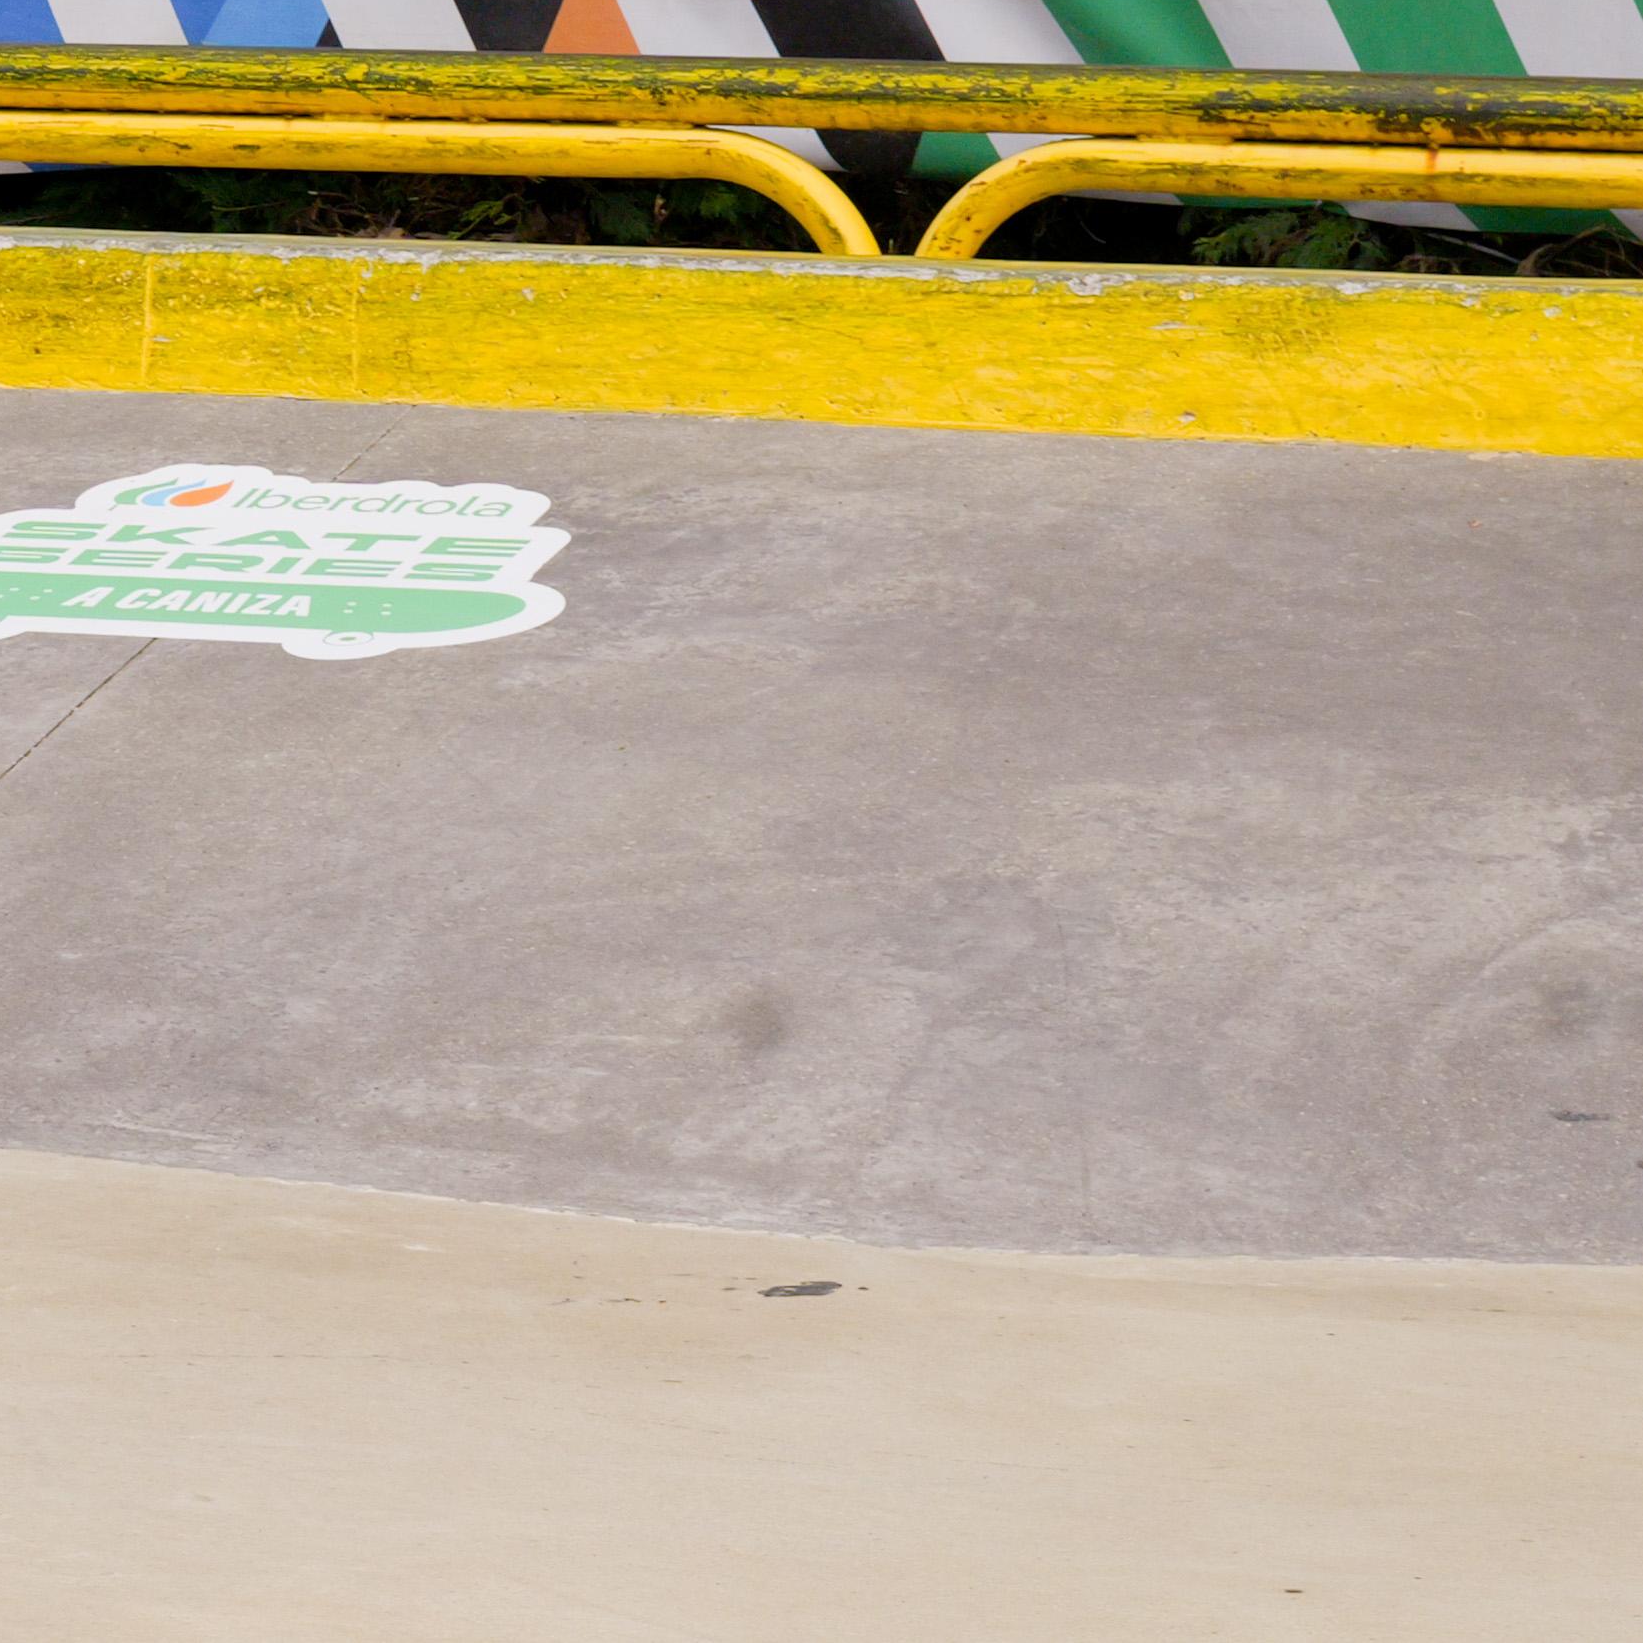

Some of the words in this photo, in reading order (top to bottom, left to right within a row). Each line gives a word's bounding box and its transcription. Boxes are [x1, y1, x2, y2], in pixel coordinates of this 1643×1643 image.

[233, 487, 514, 517] Iberdrola
[2, 521, 531, 557] SKATE
[60, 586, 114, 607] A
[114, 587, 312, 617] CANIZA
